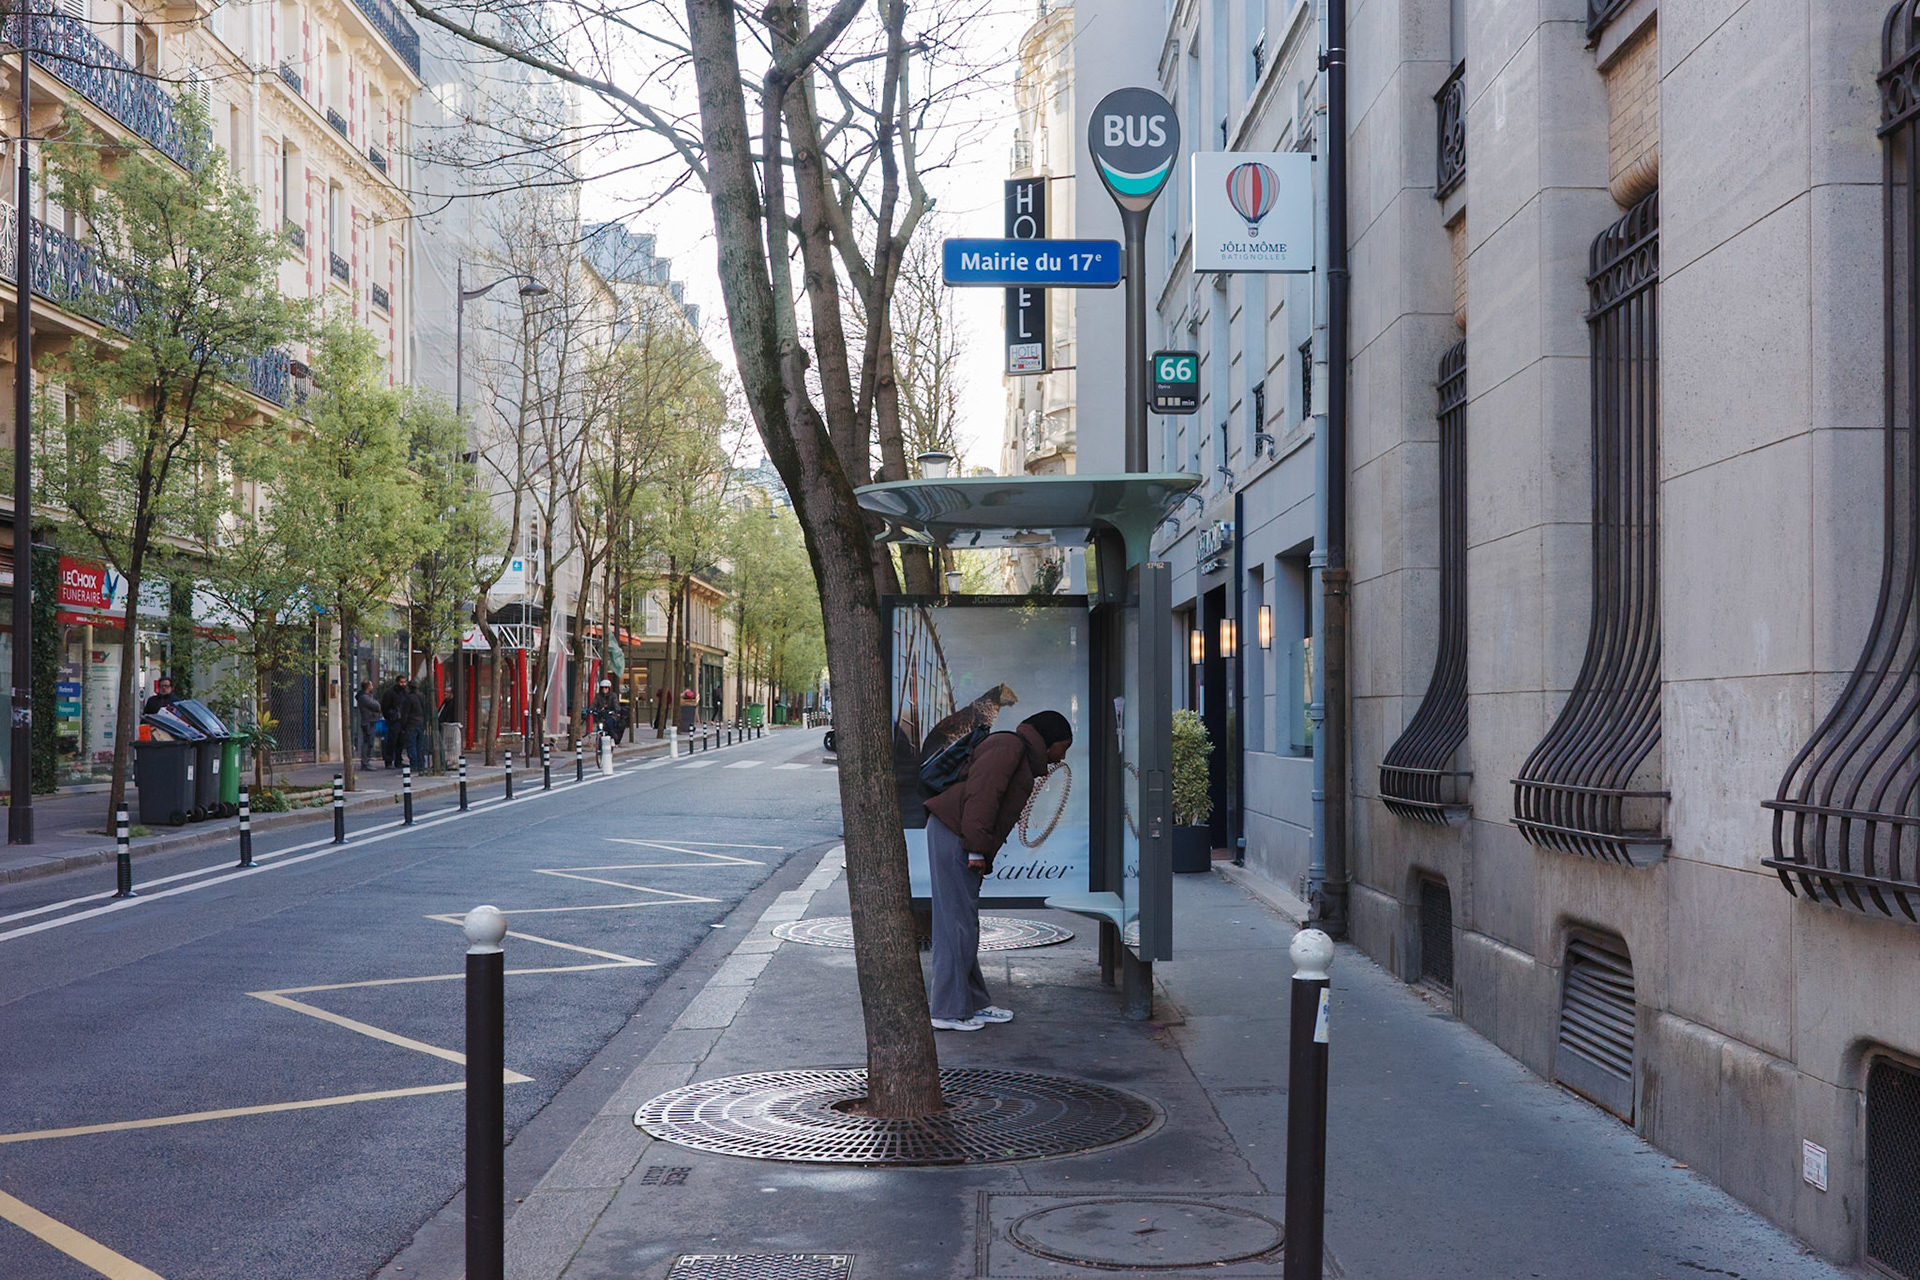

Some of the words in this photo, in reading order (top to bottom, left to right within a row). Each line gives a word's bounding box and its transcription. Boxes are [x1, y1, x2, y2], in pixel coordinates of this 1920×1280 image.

[1104, 114, 1167, 147] BUS
[1220, 240, 1246, 252] JÔLI
[1249, 240, 1288, 252] MÔME
[961, 252, 1029, 271] Mairie
[1035, 252, 1062, 271] du
[1013, 183, 1037, 338] HOEL
[1011, 346, 1039, 357] HOTEL
[1160, 358, 1192, 381] 66
[972, 595, 1016, 604] JCDecaux
[983, 860, 1074, 881] artier
